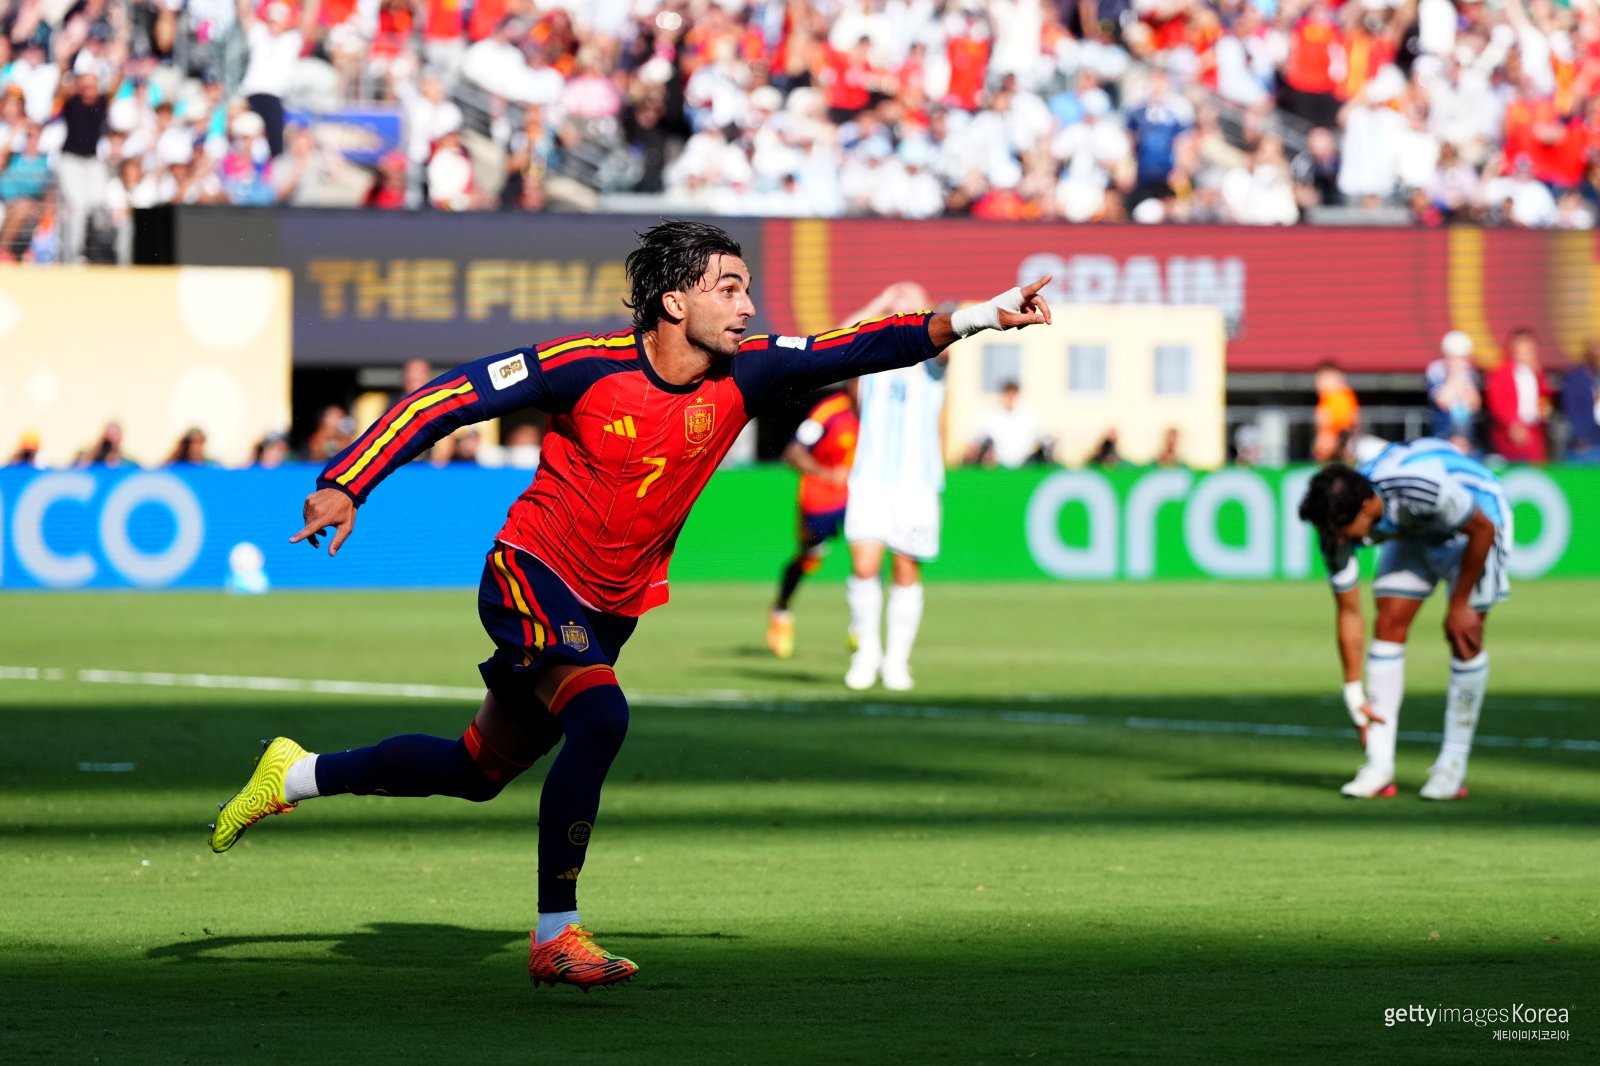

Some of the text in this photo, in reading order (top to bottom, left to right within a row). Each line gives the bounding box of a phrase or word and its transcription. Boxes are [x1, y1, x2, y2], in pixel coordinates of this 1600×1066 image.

[308, 259, 635, 321] THE FINA
[636, 456, 667, 498] 7
[0, 470, 205, 588] CO
[1026, 468, 1572, 580] arao
